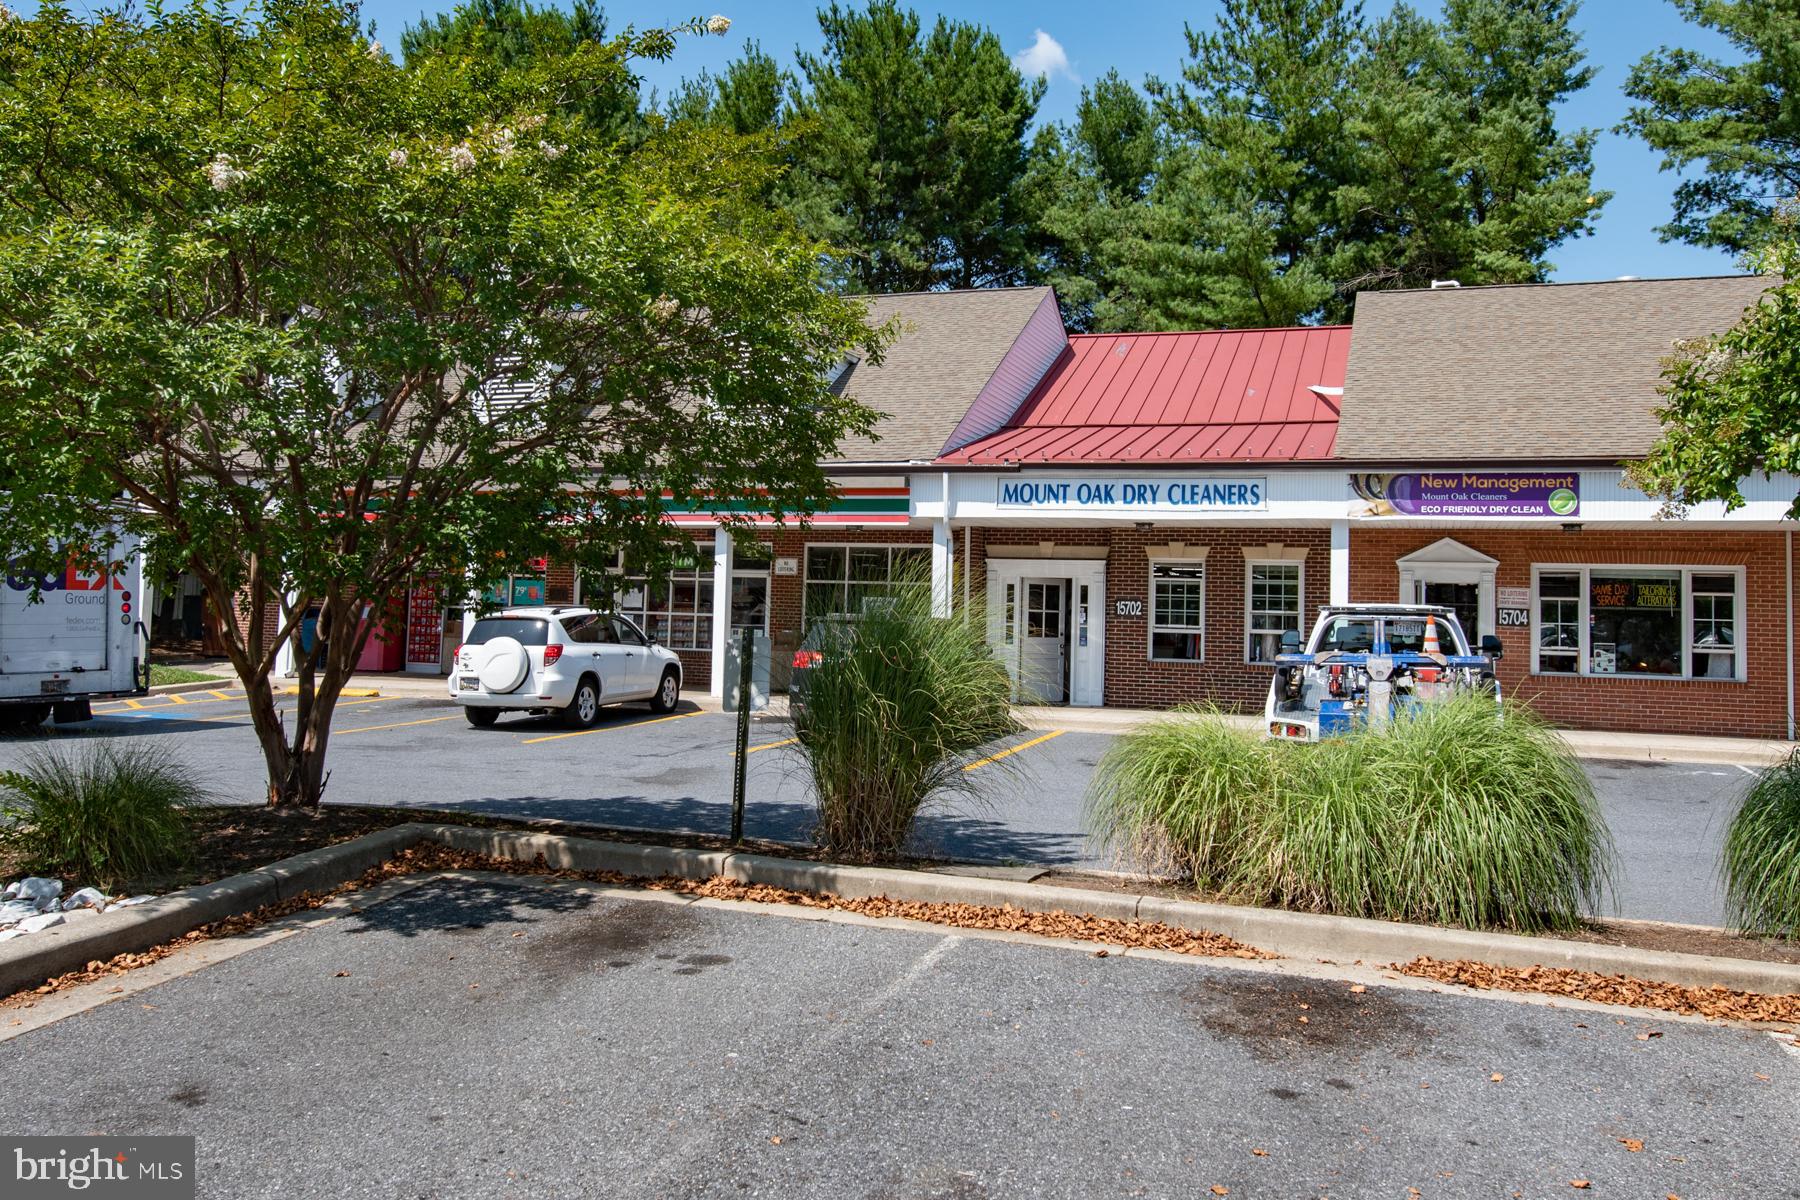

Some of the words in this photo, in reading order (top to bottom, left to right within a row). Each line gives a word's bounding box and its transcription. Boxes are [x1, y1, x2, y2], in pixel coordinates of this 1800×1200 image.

[1421, 475, 1457, 488] New
[1462, 475, 1573, 493] Management
[1002, 483, 1070, 504] MOUNT
[1077, 483, 1115, 505] OAK
[1123, 483, 1160, 505] DRY
[1167, 483, 1260, 506] CLEANERS
[1422, 492, 1449, 500] Mount
[1451, 492, 1468, 500] Oak
[1470, 492, 1508, 501] Cleaners
[1593, 585, 1613, 595] SAME
[1615, 584, 1630, 595] DAY
[65, 592, 106, 605] Ground
[1597, 595, 1625, 606] SERVICE
[1637, 595, 1677, 607] ALTERATIONS
[1116, 601, 1142, 615] 15702
[1499, 609, 1528, 625] 15704
